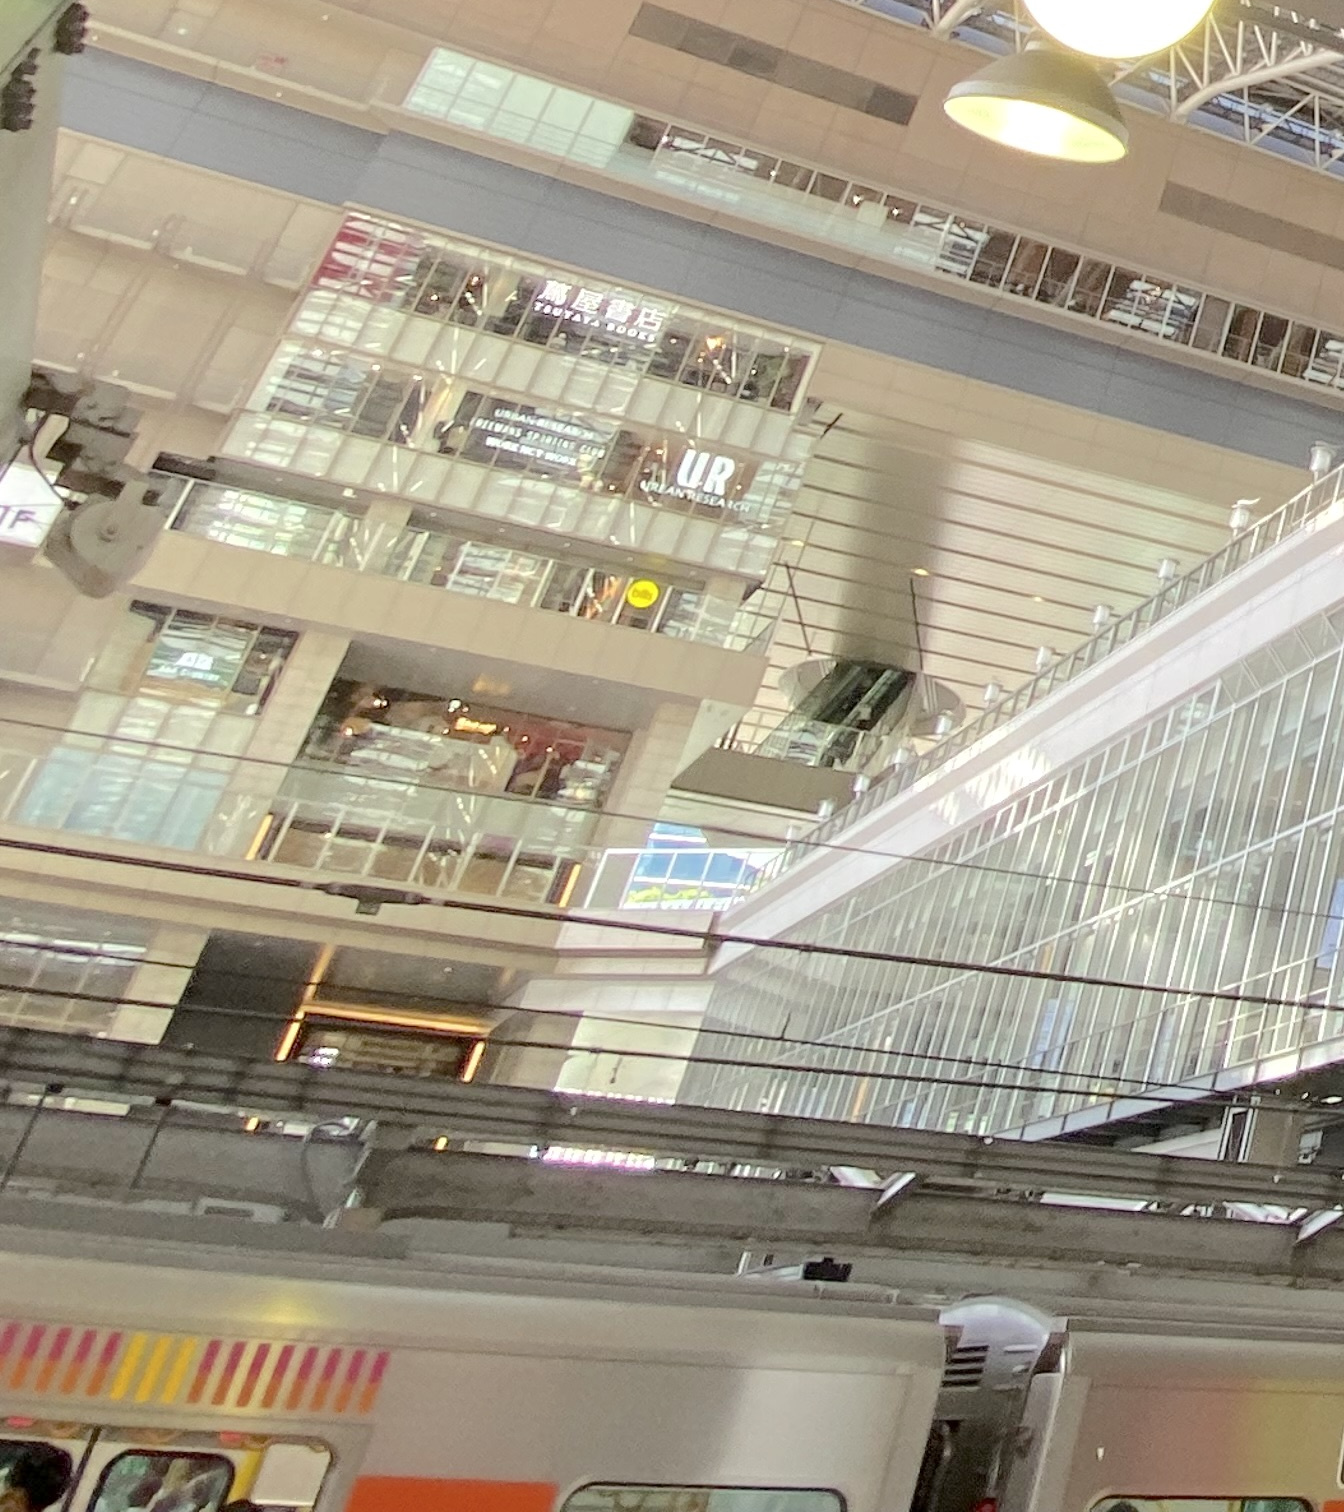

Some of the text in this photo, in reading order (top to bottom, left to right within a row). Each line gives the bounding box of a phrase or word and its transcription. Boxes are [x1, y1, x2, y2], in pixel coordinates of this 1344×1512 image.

[533, 301, 656, 343] TSUTAYA BOOKS
[677, 448, 736, 496] UR
